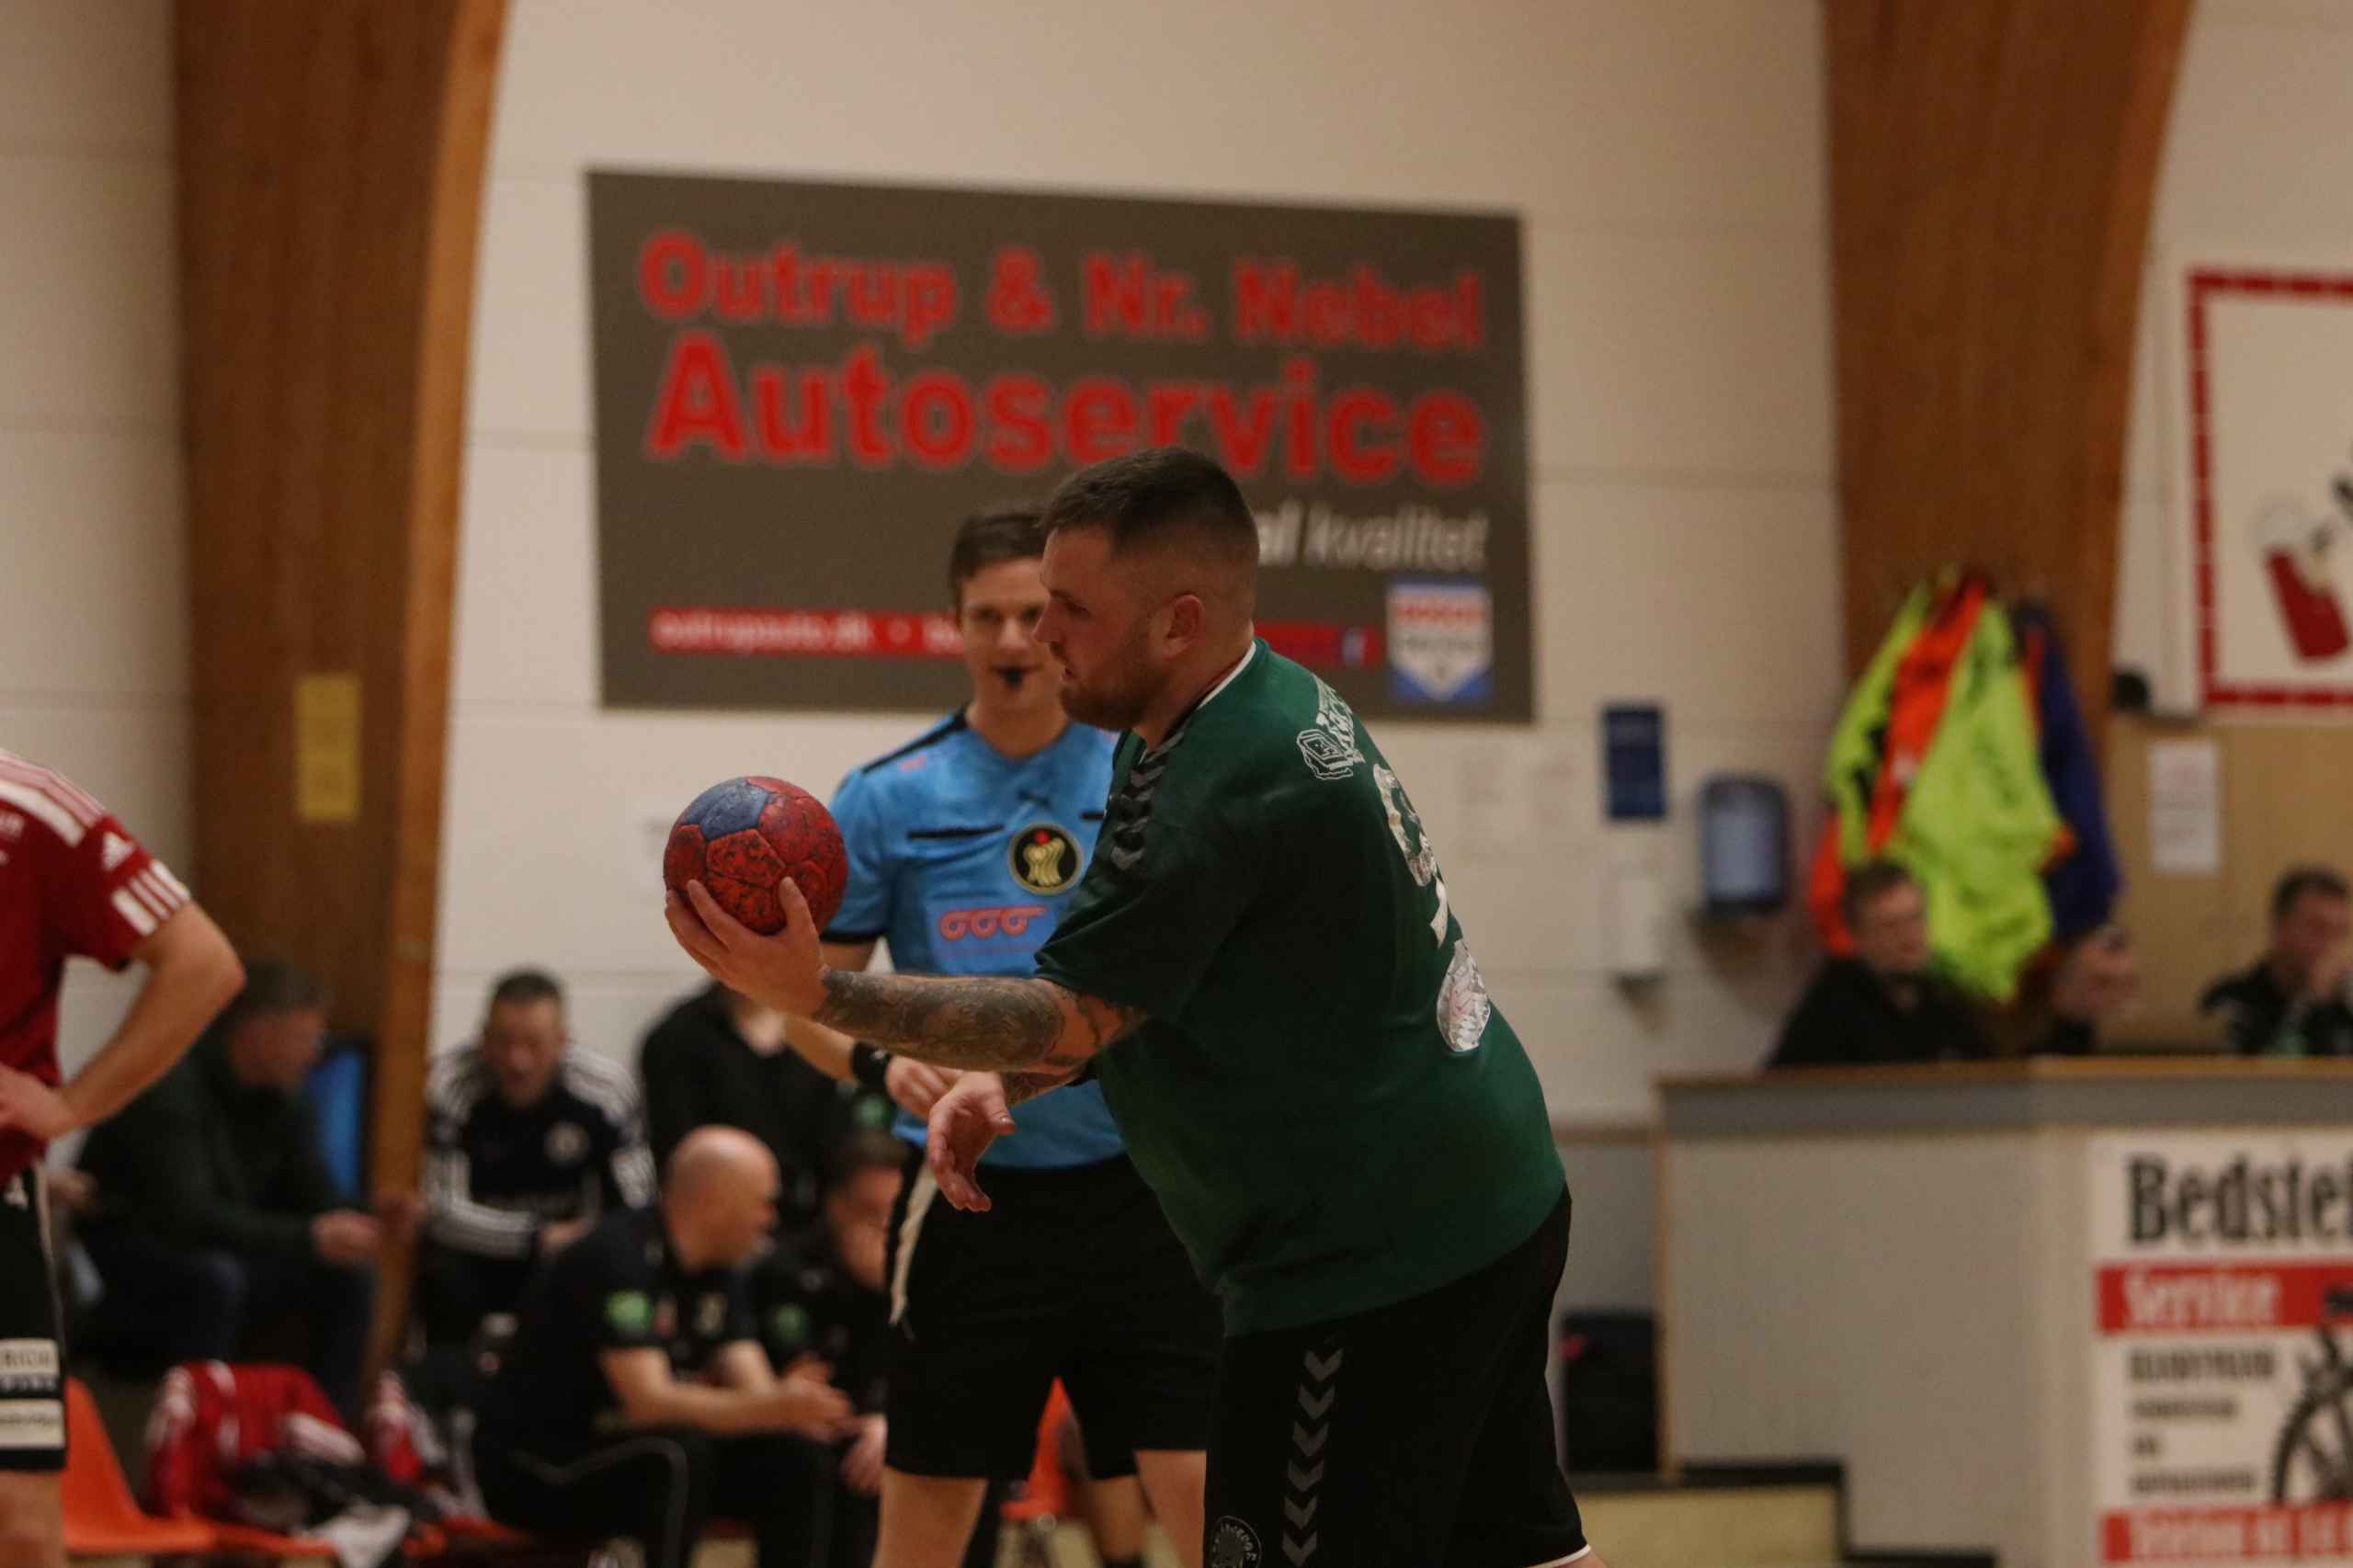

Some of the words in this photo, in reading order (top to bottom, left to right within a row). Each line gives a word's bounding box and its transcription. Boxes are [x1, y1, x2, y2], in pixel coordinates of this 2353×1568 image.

[641, 232, 957, 349] Outrup
[987, 245, 1054, 334] &
[1085, 252, 1205, 338] Nr.
[1233, 257, 1484, 350] Nebel
[649, 334, 1484, 485] Autoservice
[2126, 1153, 2353, 1242] Bedste
